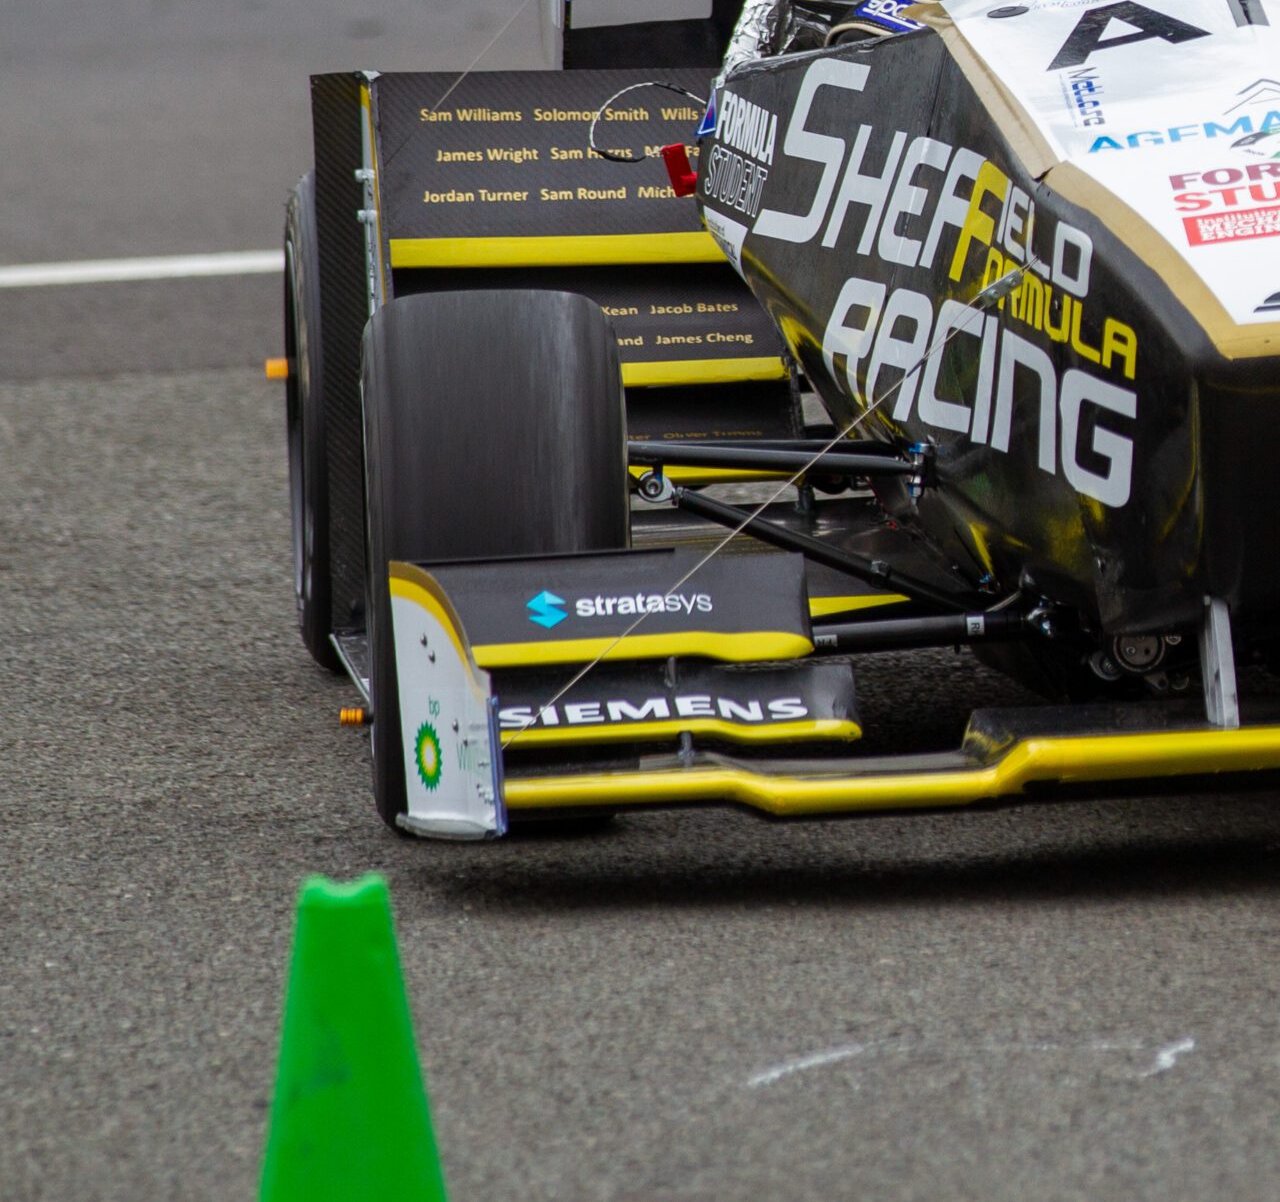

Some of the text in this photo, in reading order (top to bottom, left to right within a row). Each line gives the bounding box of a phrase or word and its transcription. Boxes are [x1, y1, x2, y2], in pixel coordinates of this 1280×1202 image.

[420, 107, 698, 122] Sam Williams Solomon Smith Wills
[715, 90, 778, 166] FORMULA
[436, 149, 483, 163] James
[487, 148, 539, 162] Wright
[551, 147, 583, 160] Sam
[704, 144, 769, 218] STUDENT
[424, 190, 474, 204] Jordan
[478, 189, 529, 203] Turner
[540, 188, 573, 201] Sam
[577, 187, 626, 201] Round
[650, 303, 693, 315] Jacob
[697, 302, 738, 312] Bates
[655, 334, 702, 345] James
[706, 332, 754, 344] Cheng
[822, 277, 1138, 507] RACING
[575, 591, 713, 618] stratasys
[498, 696, 808, 728] SIEMENS
